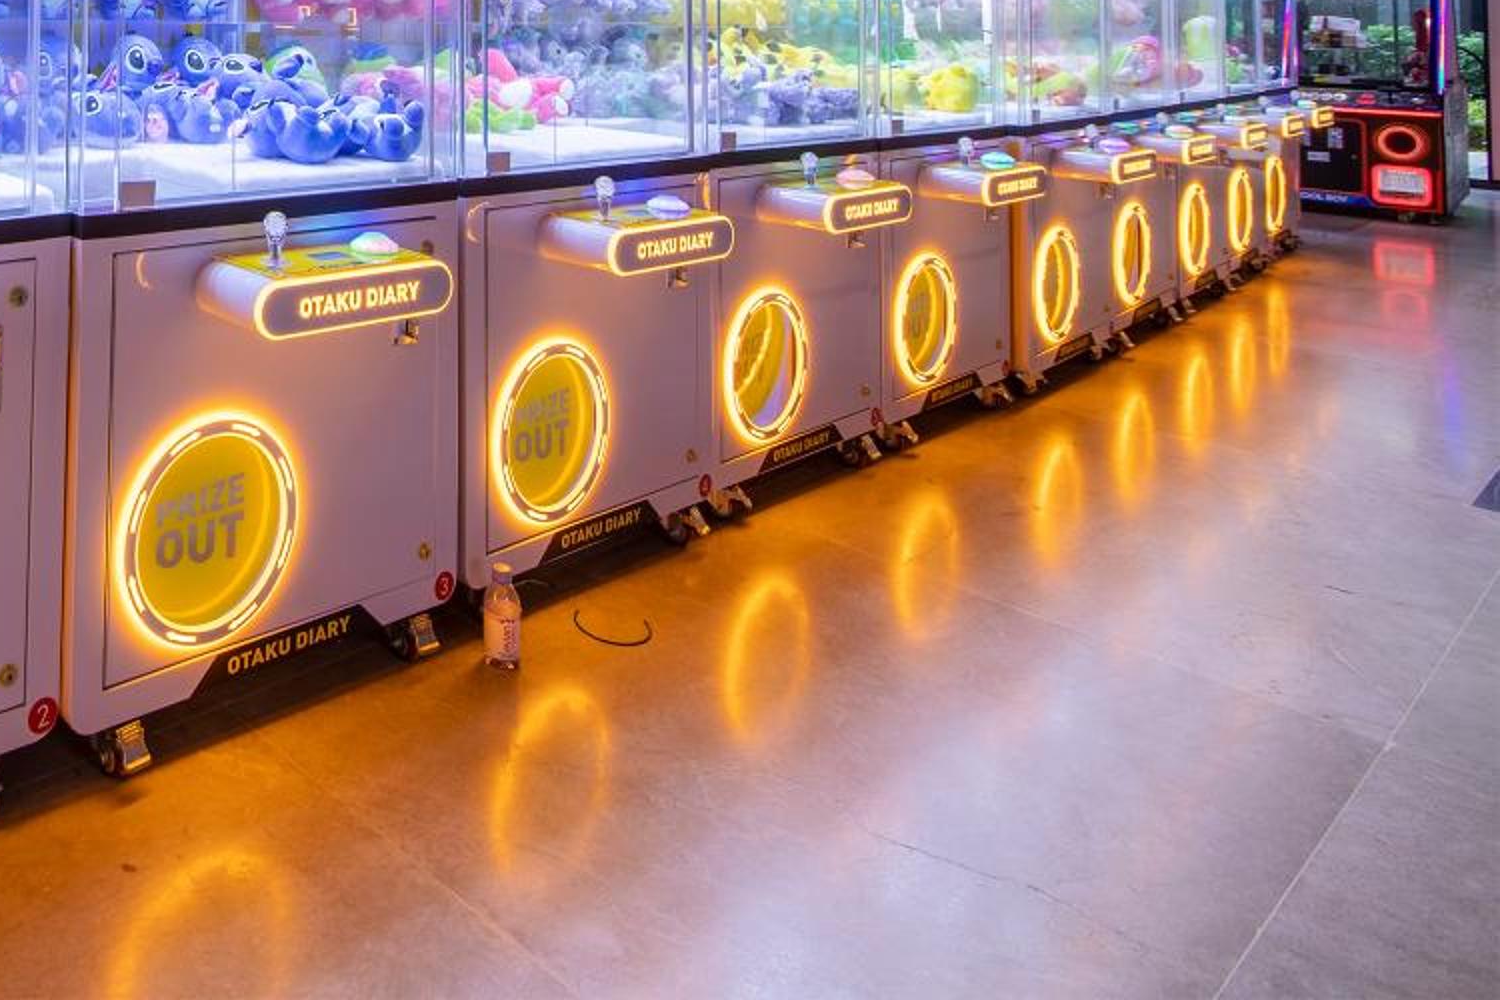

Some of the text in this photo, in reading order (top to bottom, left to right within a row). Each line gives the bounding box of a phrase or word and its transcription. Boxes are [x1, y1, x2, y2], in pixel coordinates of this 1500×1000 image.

[637, 231, 714, 260] OTAKU DIARY
[299, 279, 420, 319] OTAKU DIARY
[513, 419, 571, 463] OUT
[155, 472, 246, 529] PRIZE
[155, 511, 246, 570] OUT
[560, 507, 642, 549] OTAKU DIARY
[438, 576, 451, 596] 3
[227, 614, 353, 675] OTAKU DIARY
[35, 703, 52, 729] 2
